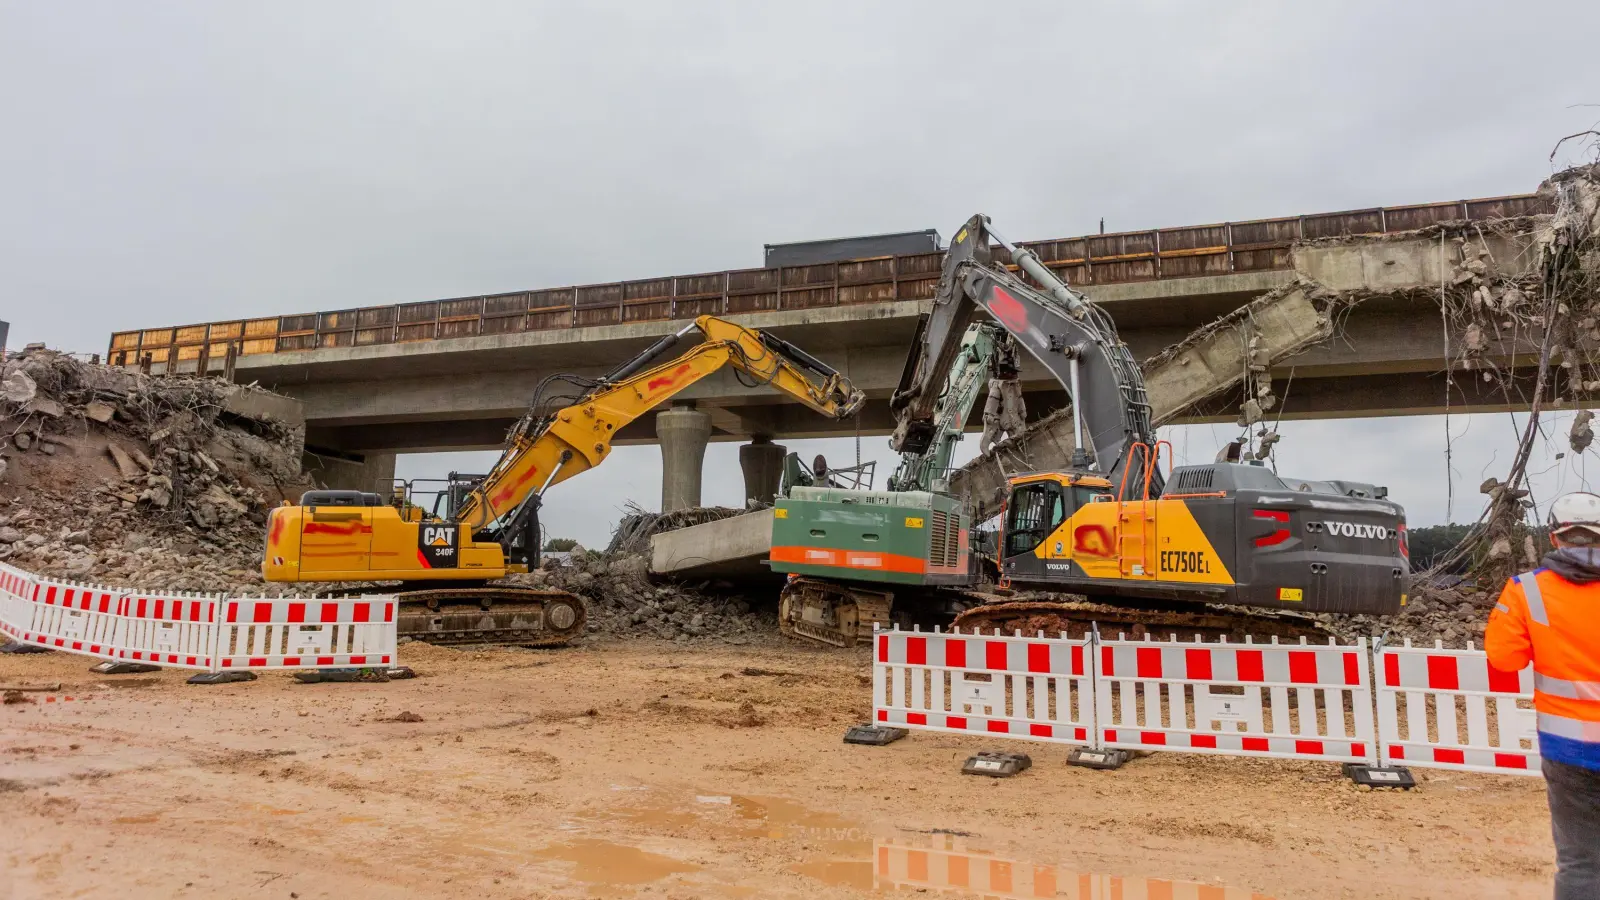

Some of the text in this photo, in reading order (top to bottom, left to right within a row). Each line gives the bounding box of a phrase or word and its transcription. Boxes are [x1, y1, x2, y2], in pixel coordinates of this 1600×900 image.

[423, 527, 455, 546] CAT
[1324, 520, 1387, 540] VOLVO
[435, 548, 454, 556] 340F
